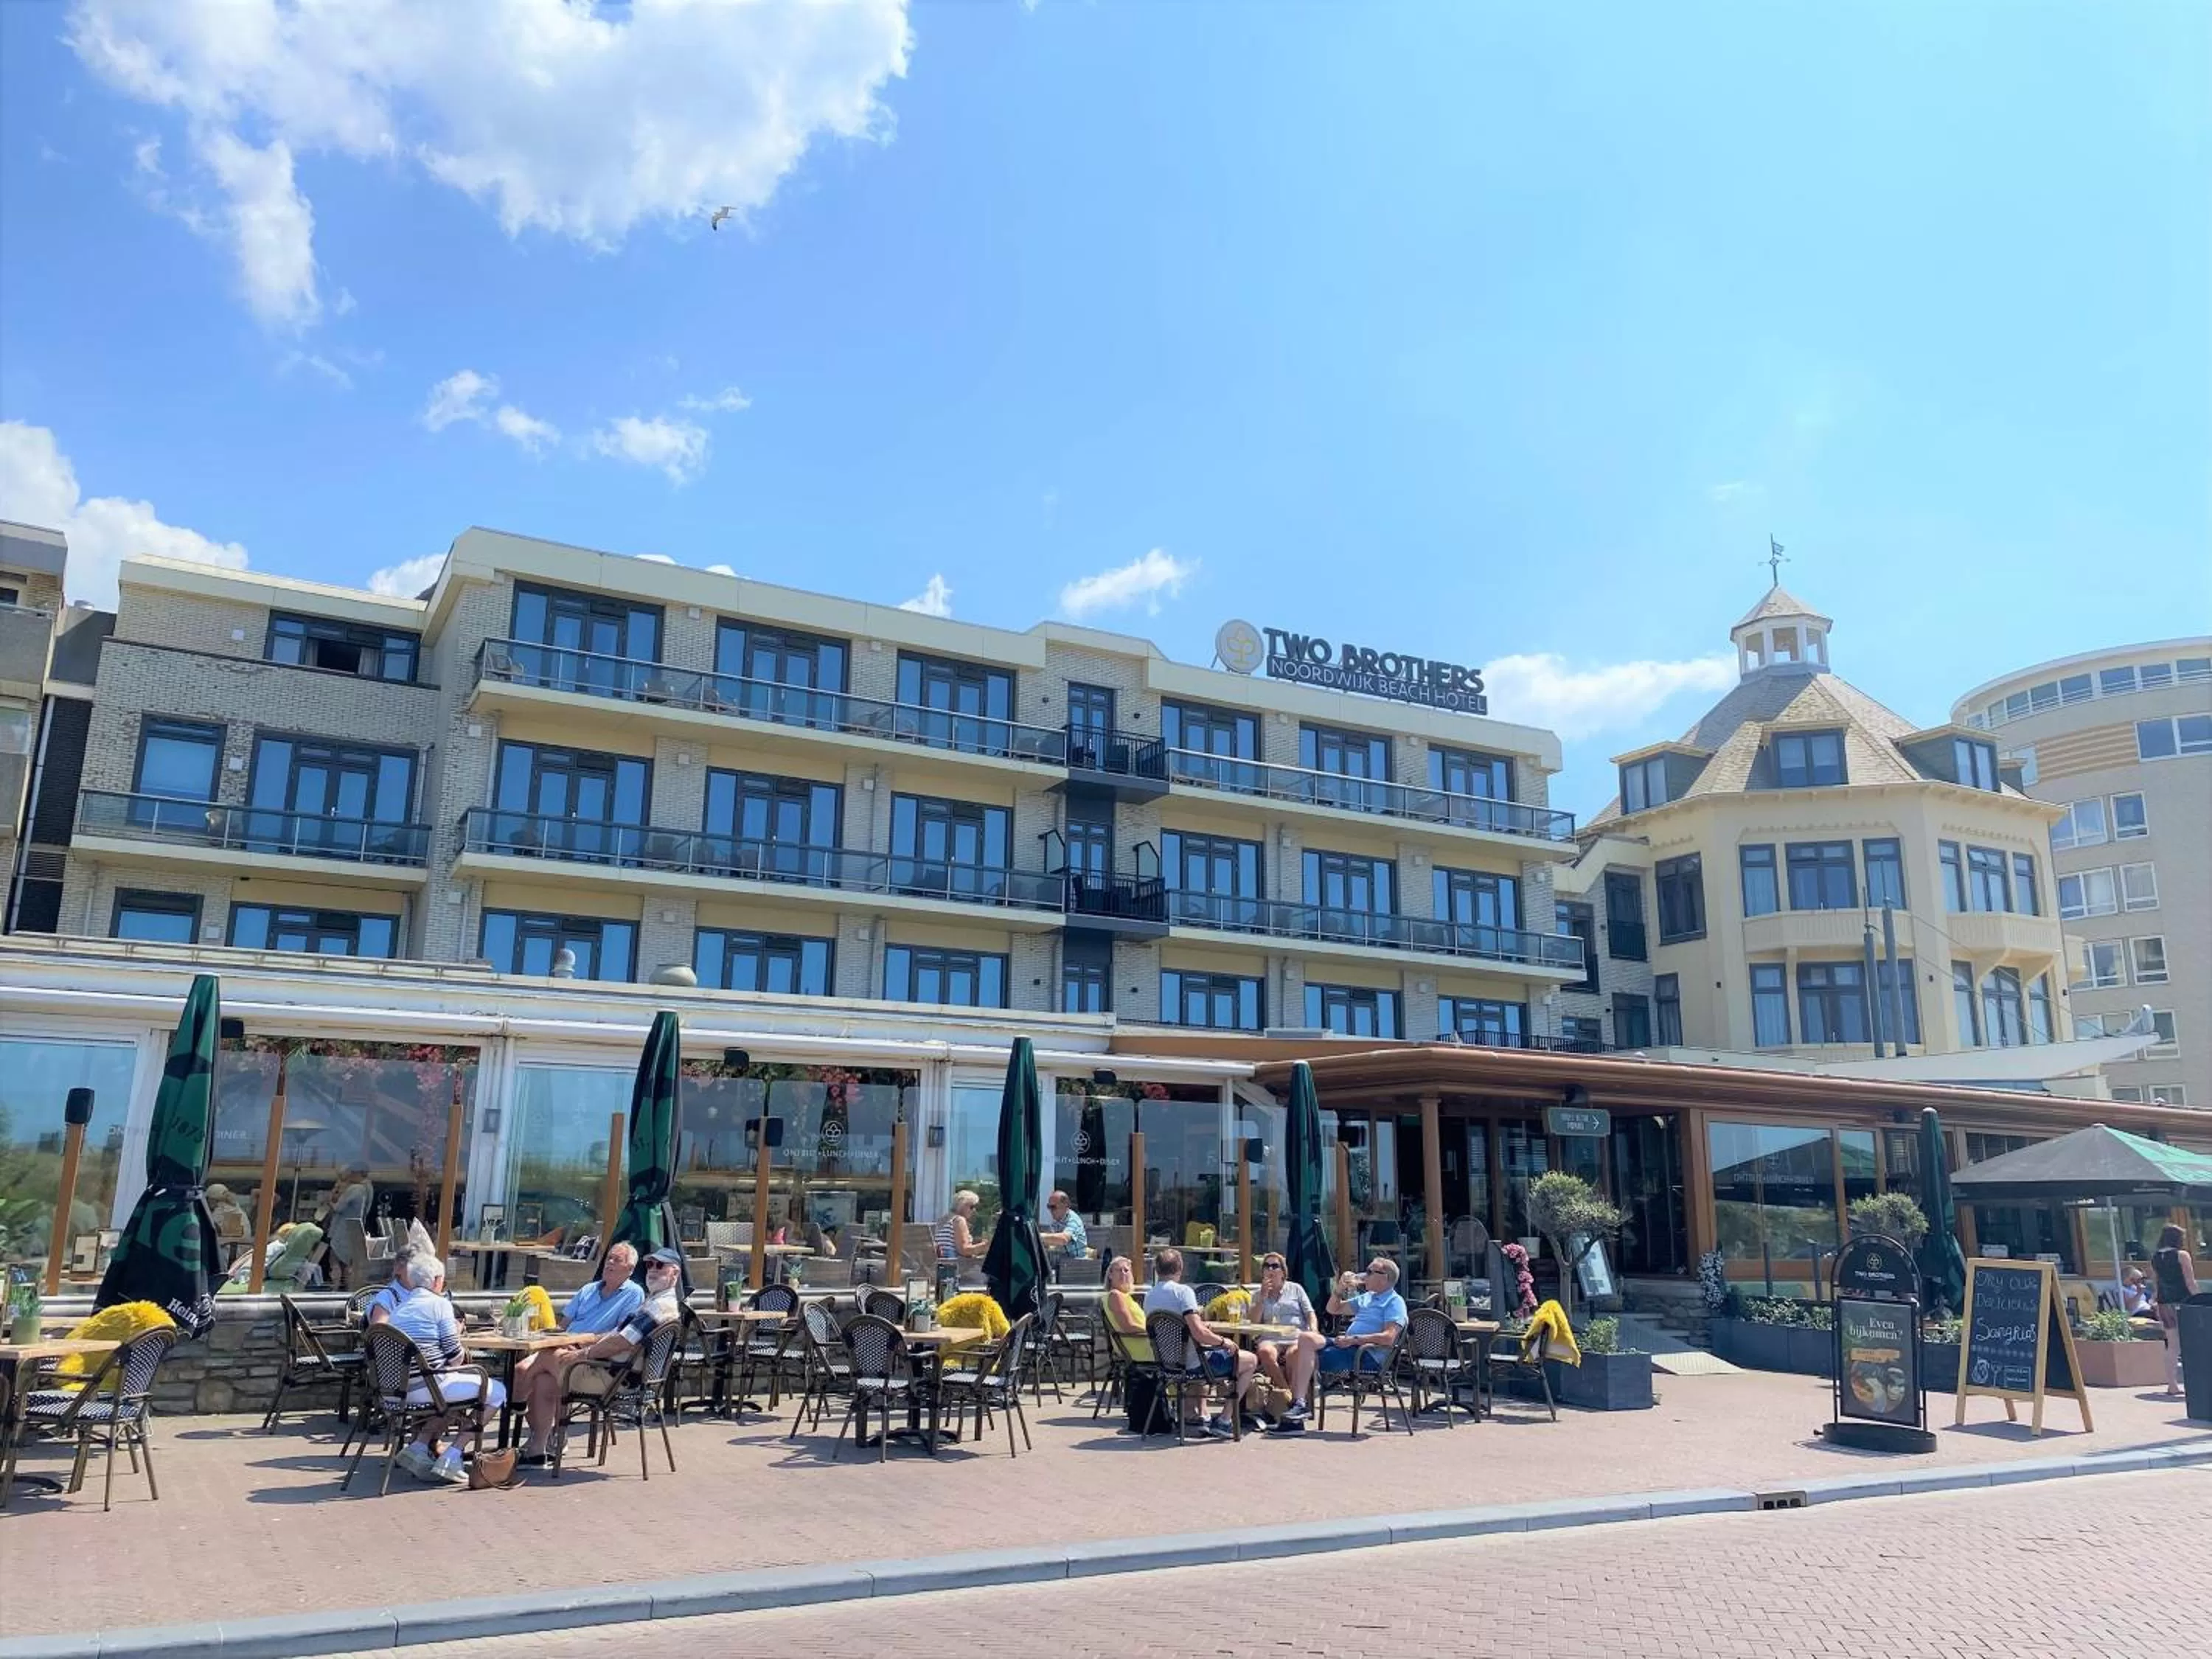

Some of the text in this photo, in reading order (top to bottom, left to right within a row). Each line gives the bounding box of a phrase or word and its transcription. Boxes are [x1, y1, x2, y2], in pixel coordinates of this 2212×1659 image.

[1262, 627, 1485, 694] TWO BROTHERS
[1270, 660, 1486, 712] NOORDWIJK BEACH HOTEL
[167, 1298, 199, 1327] Hein
[1869, 1317, 1894, 1329] Even
